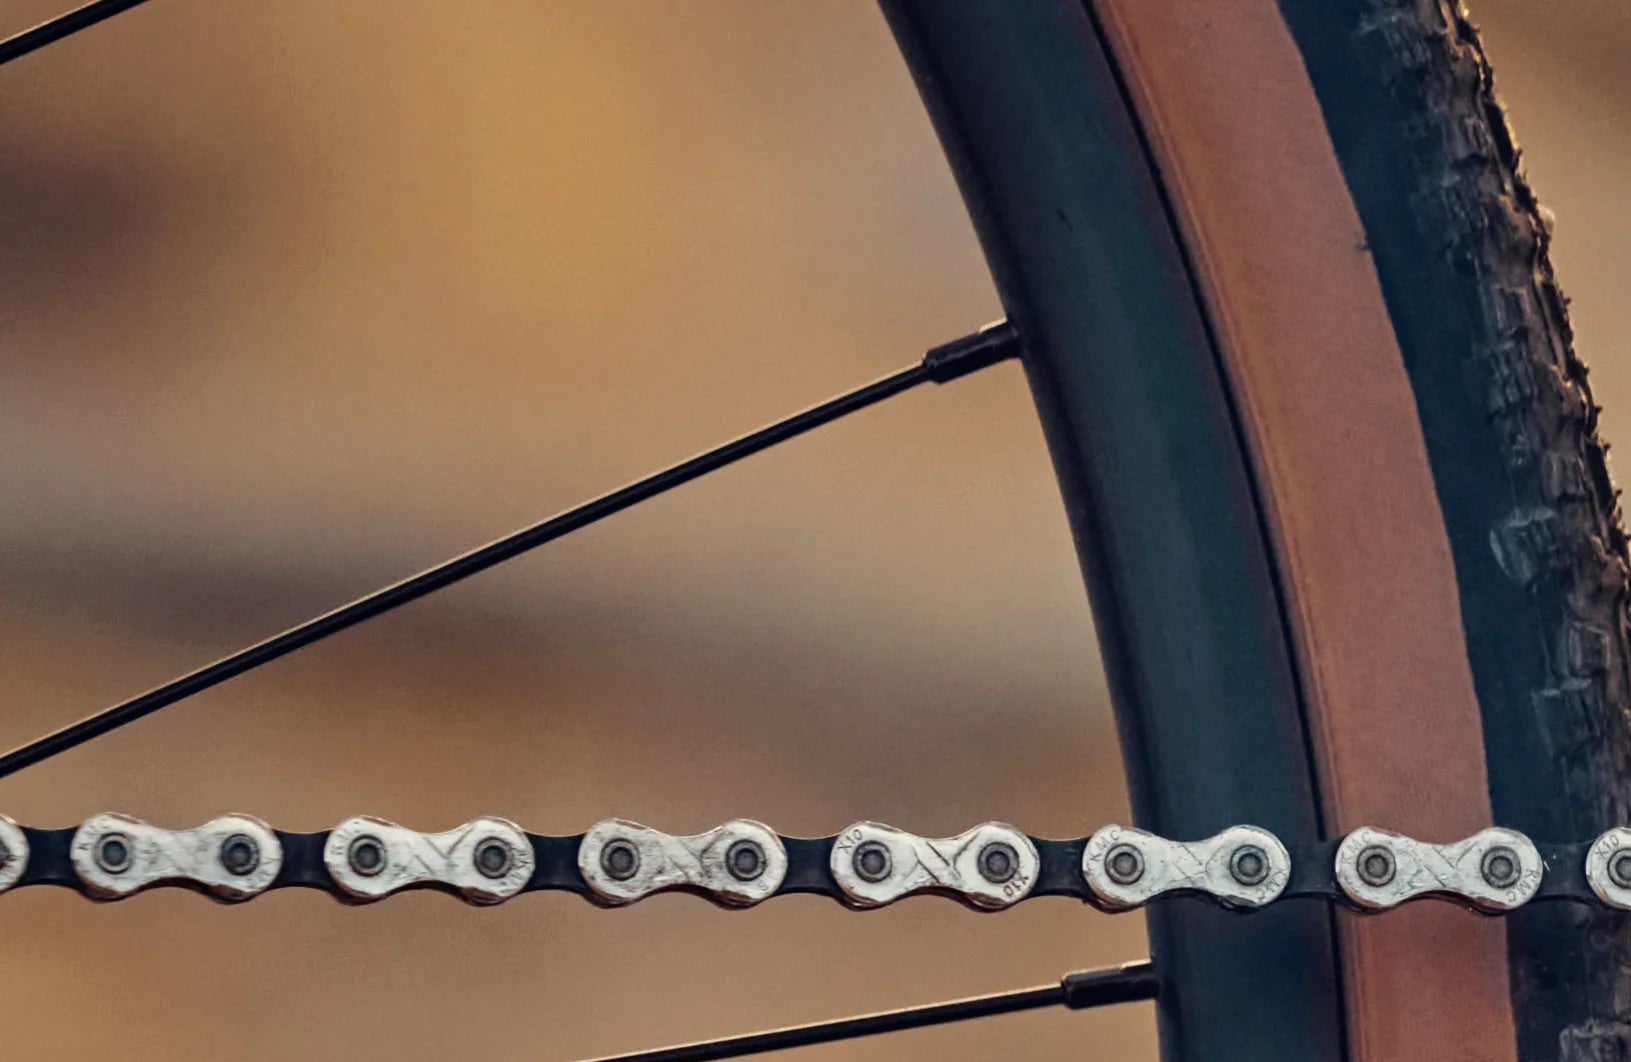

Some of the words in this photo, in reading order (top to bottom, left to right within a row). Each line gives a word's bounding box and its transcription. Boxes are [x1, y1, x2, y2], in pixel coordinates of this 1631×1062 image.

[837, 829, 864, 854] X10
[1088, 830, 1120, 862] KMC
[1340, 831, 1372, 865] KMC
[1595, 834, 1620, 861] X10
[1003, 871, 1029, 898] X10
[1508, 868, 1540, 903] KMC
